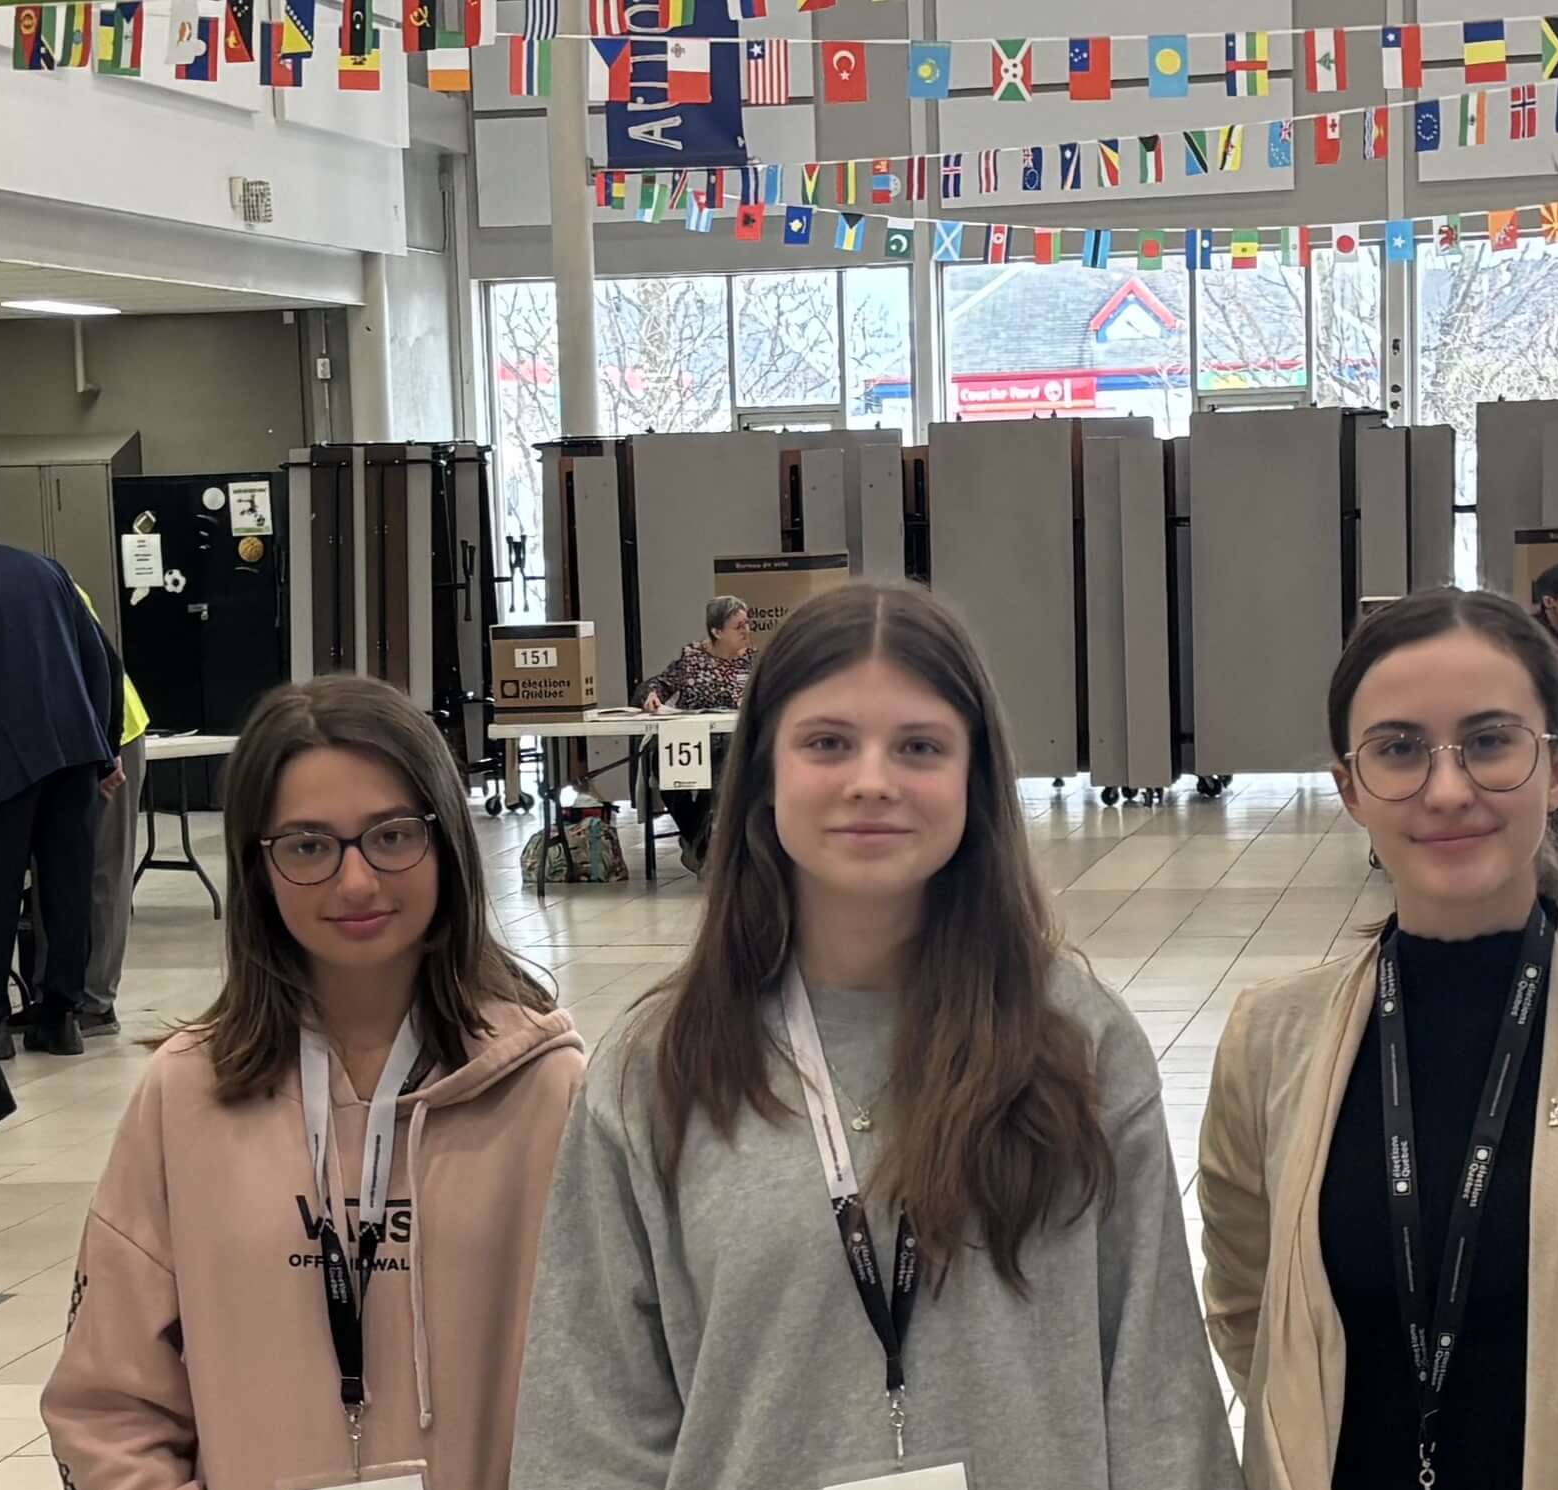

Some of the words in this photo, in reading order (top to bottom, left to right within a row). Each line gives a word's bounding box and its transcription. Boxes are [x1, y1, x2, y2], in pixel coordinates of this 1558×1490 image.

[521, 650, 548, 665] 151
[664, 741, 704, 767] 151
[289, 1254, 325, 1268] OFF
[371, 1257, 411, 1271] WAL
